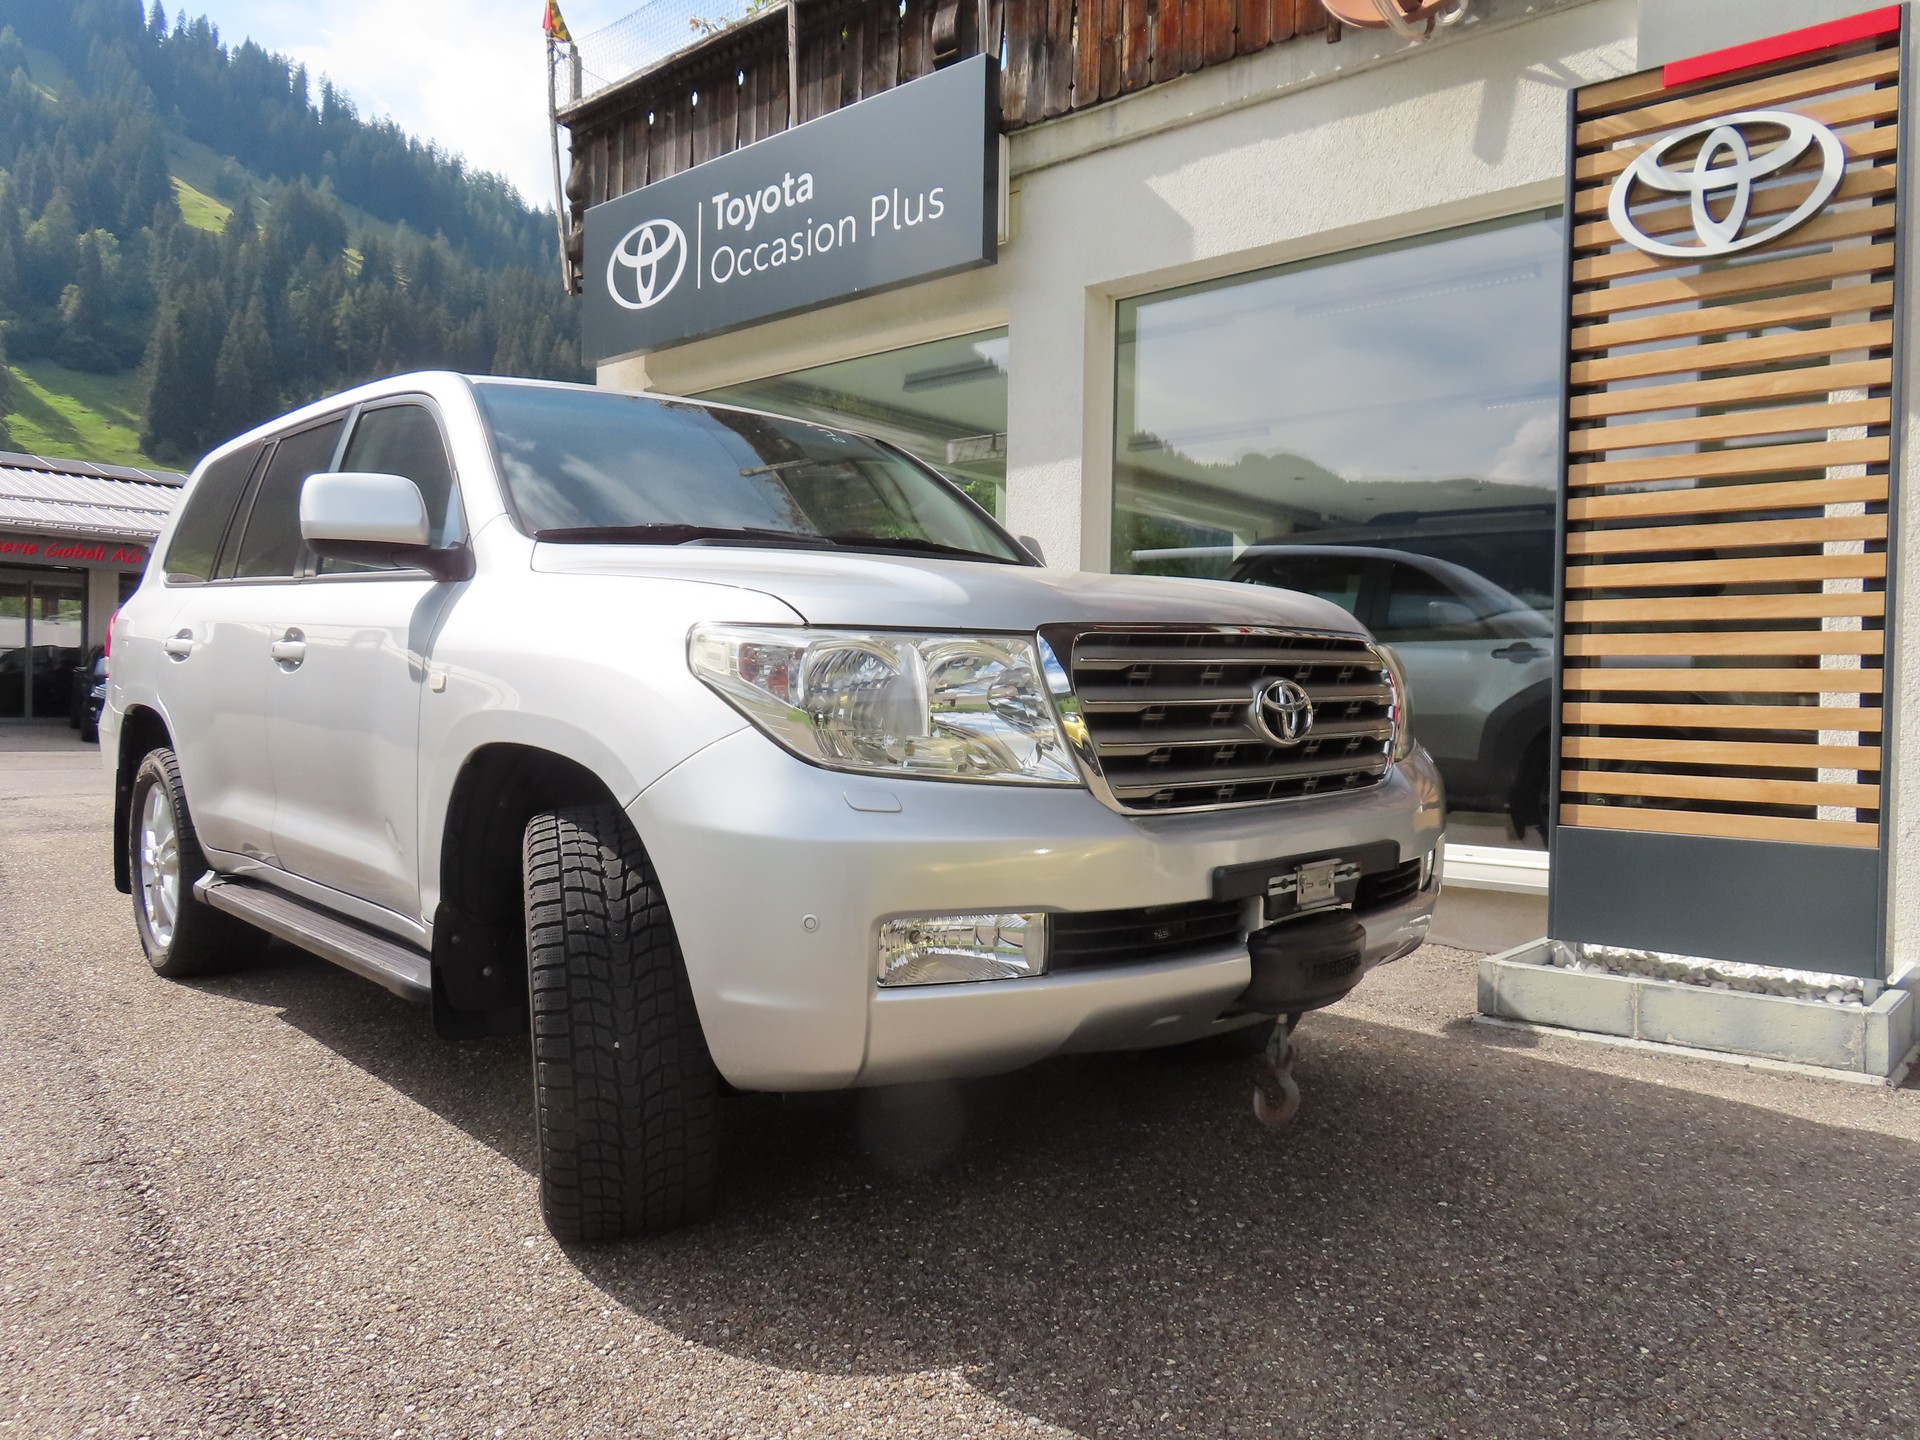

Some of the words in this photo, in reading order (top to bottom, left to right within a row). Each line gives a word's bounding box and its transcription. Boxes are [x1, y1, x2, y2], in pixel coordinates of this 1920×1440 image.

[712, 172, 813, 231] Toyota
[711, 215, 856, 283] Occasion
[871, 187, 945, 237] Plus
[0, 541, 38, 555] erie
[111, 547, 142, 563] AG
